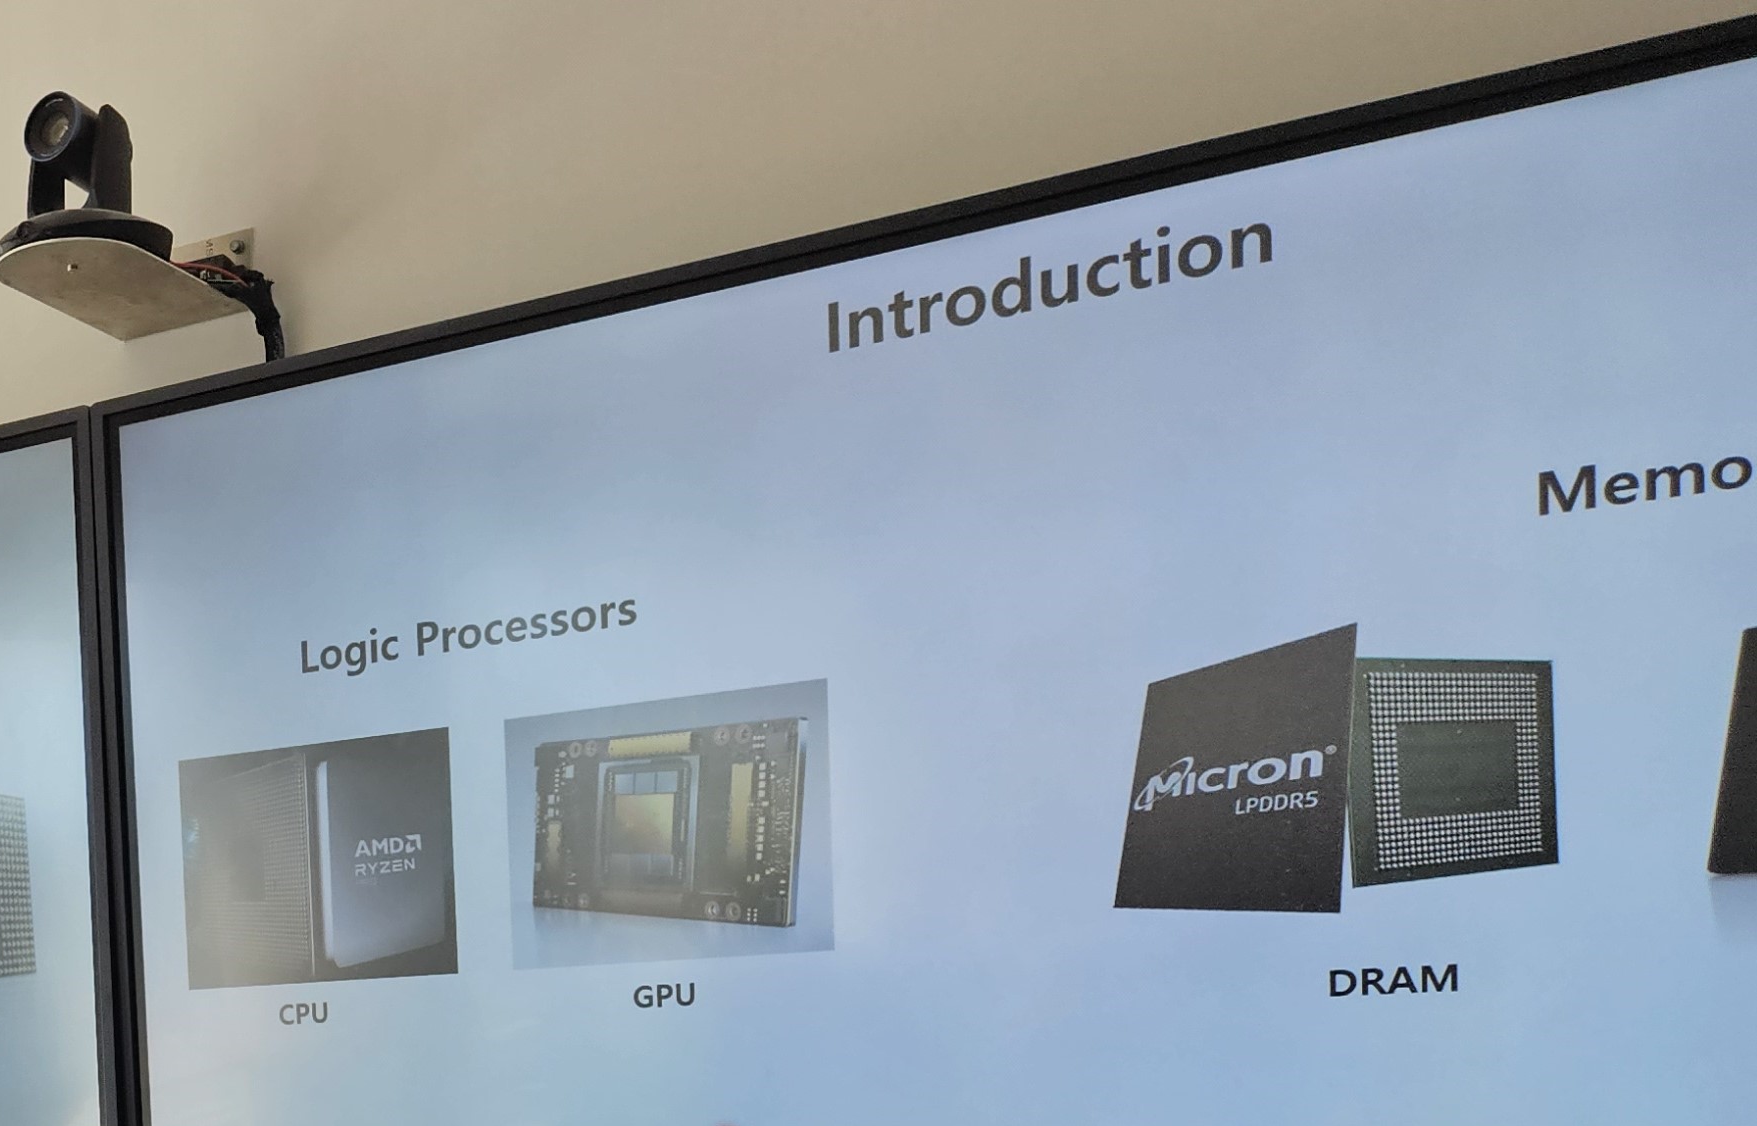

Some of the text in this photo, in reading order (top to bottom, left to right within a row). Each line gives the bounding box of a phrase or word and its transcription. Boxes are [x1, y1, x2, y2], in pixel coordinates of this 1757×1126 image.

[827, 221, 1273, 353] Introduction
[1538, 455, 1753, 516] Memo
[300, 597, 637, 677] Logic Processors
[1234, 789, 1319, 817] LPDDR5
[354, 834, 405, 857] AMD
[354, 858, 416, 877] RYZEN
[1328, 963, 1459, 998] DRAM
[632, 982, 696, 1009] GPU
[278, 1002, 329, 1026] CPU
